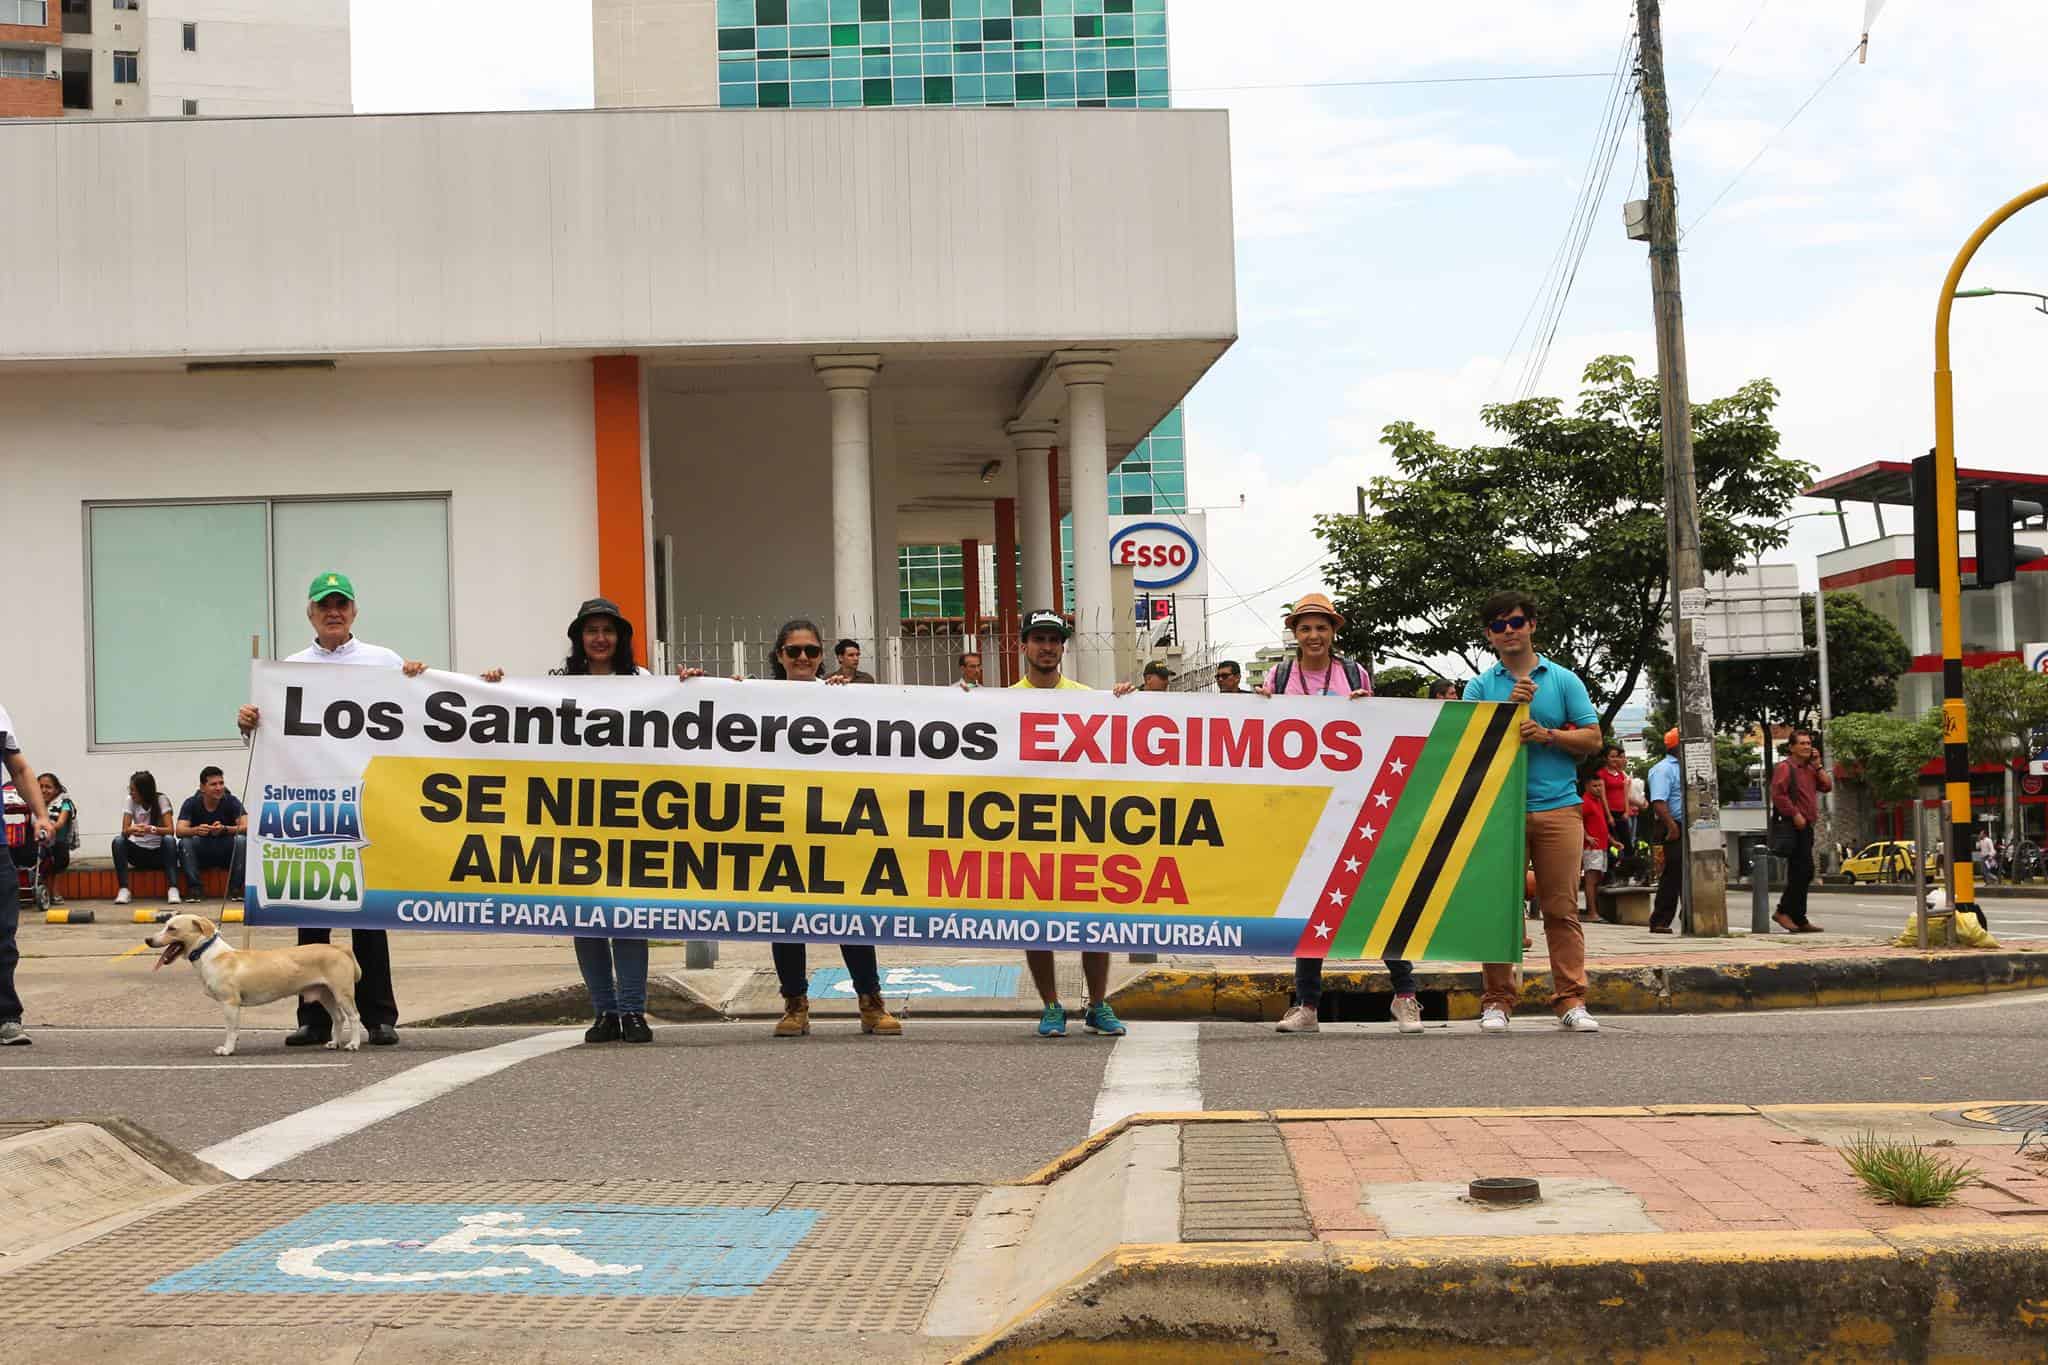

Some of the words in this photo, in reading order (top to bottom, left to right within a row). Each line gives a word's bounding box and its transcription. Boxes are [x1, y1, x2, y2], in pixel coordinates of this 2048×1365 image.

[284, 686, 404, 740] Los
[424, 691, 998, 760] Santandereanos
[1020, 712, 1362, 771] EXIGIMOS
[264, 785, 336, 801] Salvemos
[342, 787, 356, 801] el
[420, 773, 506, 824] SE
[527, 777, 785, 833] NIEGUE
[806, 787, 889, 836] LA
[909, 790, 1224, 847] LICENCIA
[258, 802, 361, 838] AGUA
[263, 844, 336, 860] Salvemos
[342, 846, 356, 860] la
[449, 834, 845, 894] AMBIENTAL
[861, 848, 909, 897] A
[928, 849, 1190, 905] MINESA
[262, 860, 358, 901] VIDA
[397, 898, 495, 924] COMITÉ
[500, 903, 569, 927] PARA
[574, 905, 607, 928] LA
[613, 907, 731, 932] DEFENSA
[737, 911, 786, 934] DEL
[791, 913, 865, 936] AGUA
[870, 915, 888, 937] Y
[893, 915, 922, 938] EL
[928, 913, 1040, 942] PÁRAMO
[1046, 920, 1080, 943] DE
[1086, 920, 1242, 947] SANTURBÁN
